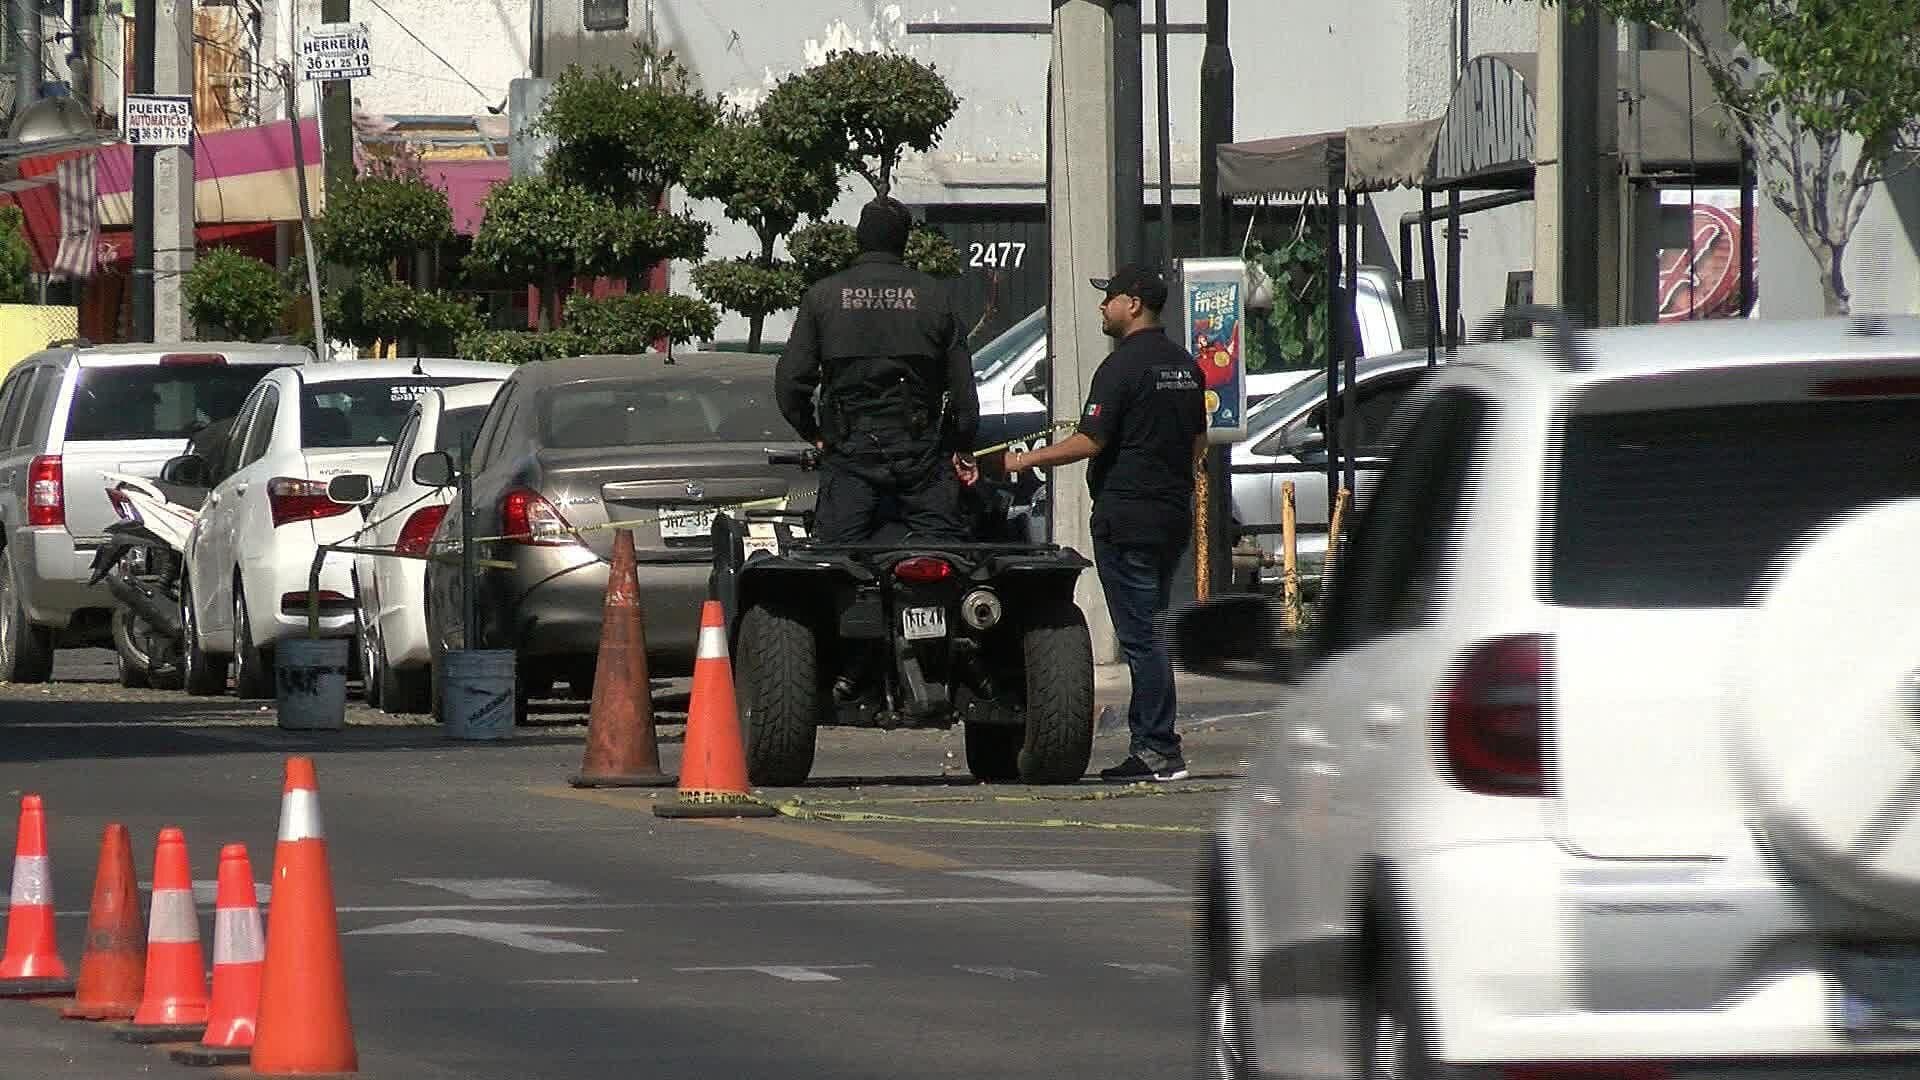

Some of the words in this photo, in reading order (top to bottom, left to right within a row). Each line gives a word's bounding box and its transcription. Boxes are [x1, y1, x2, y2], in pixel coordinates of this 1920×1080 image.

[355, 53, 369, 67] 19
[128, 103, 187, 115] PUERTAS
[969, 242, 1026, 268] 2477
[841, 299, 918, 311] ESTATAL
[391, 386, 407, 394] SE
